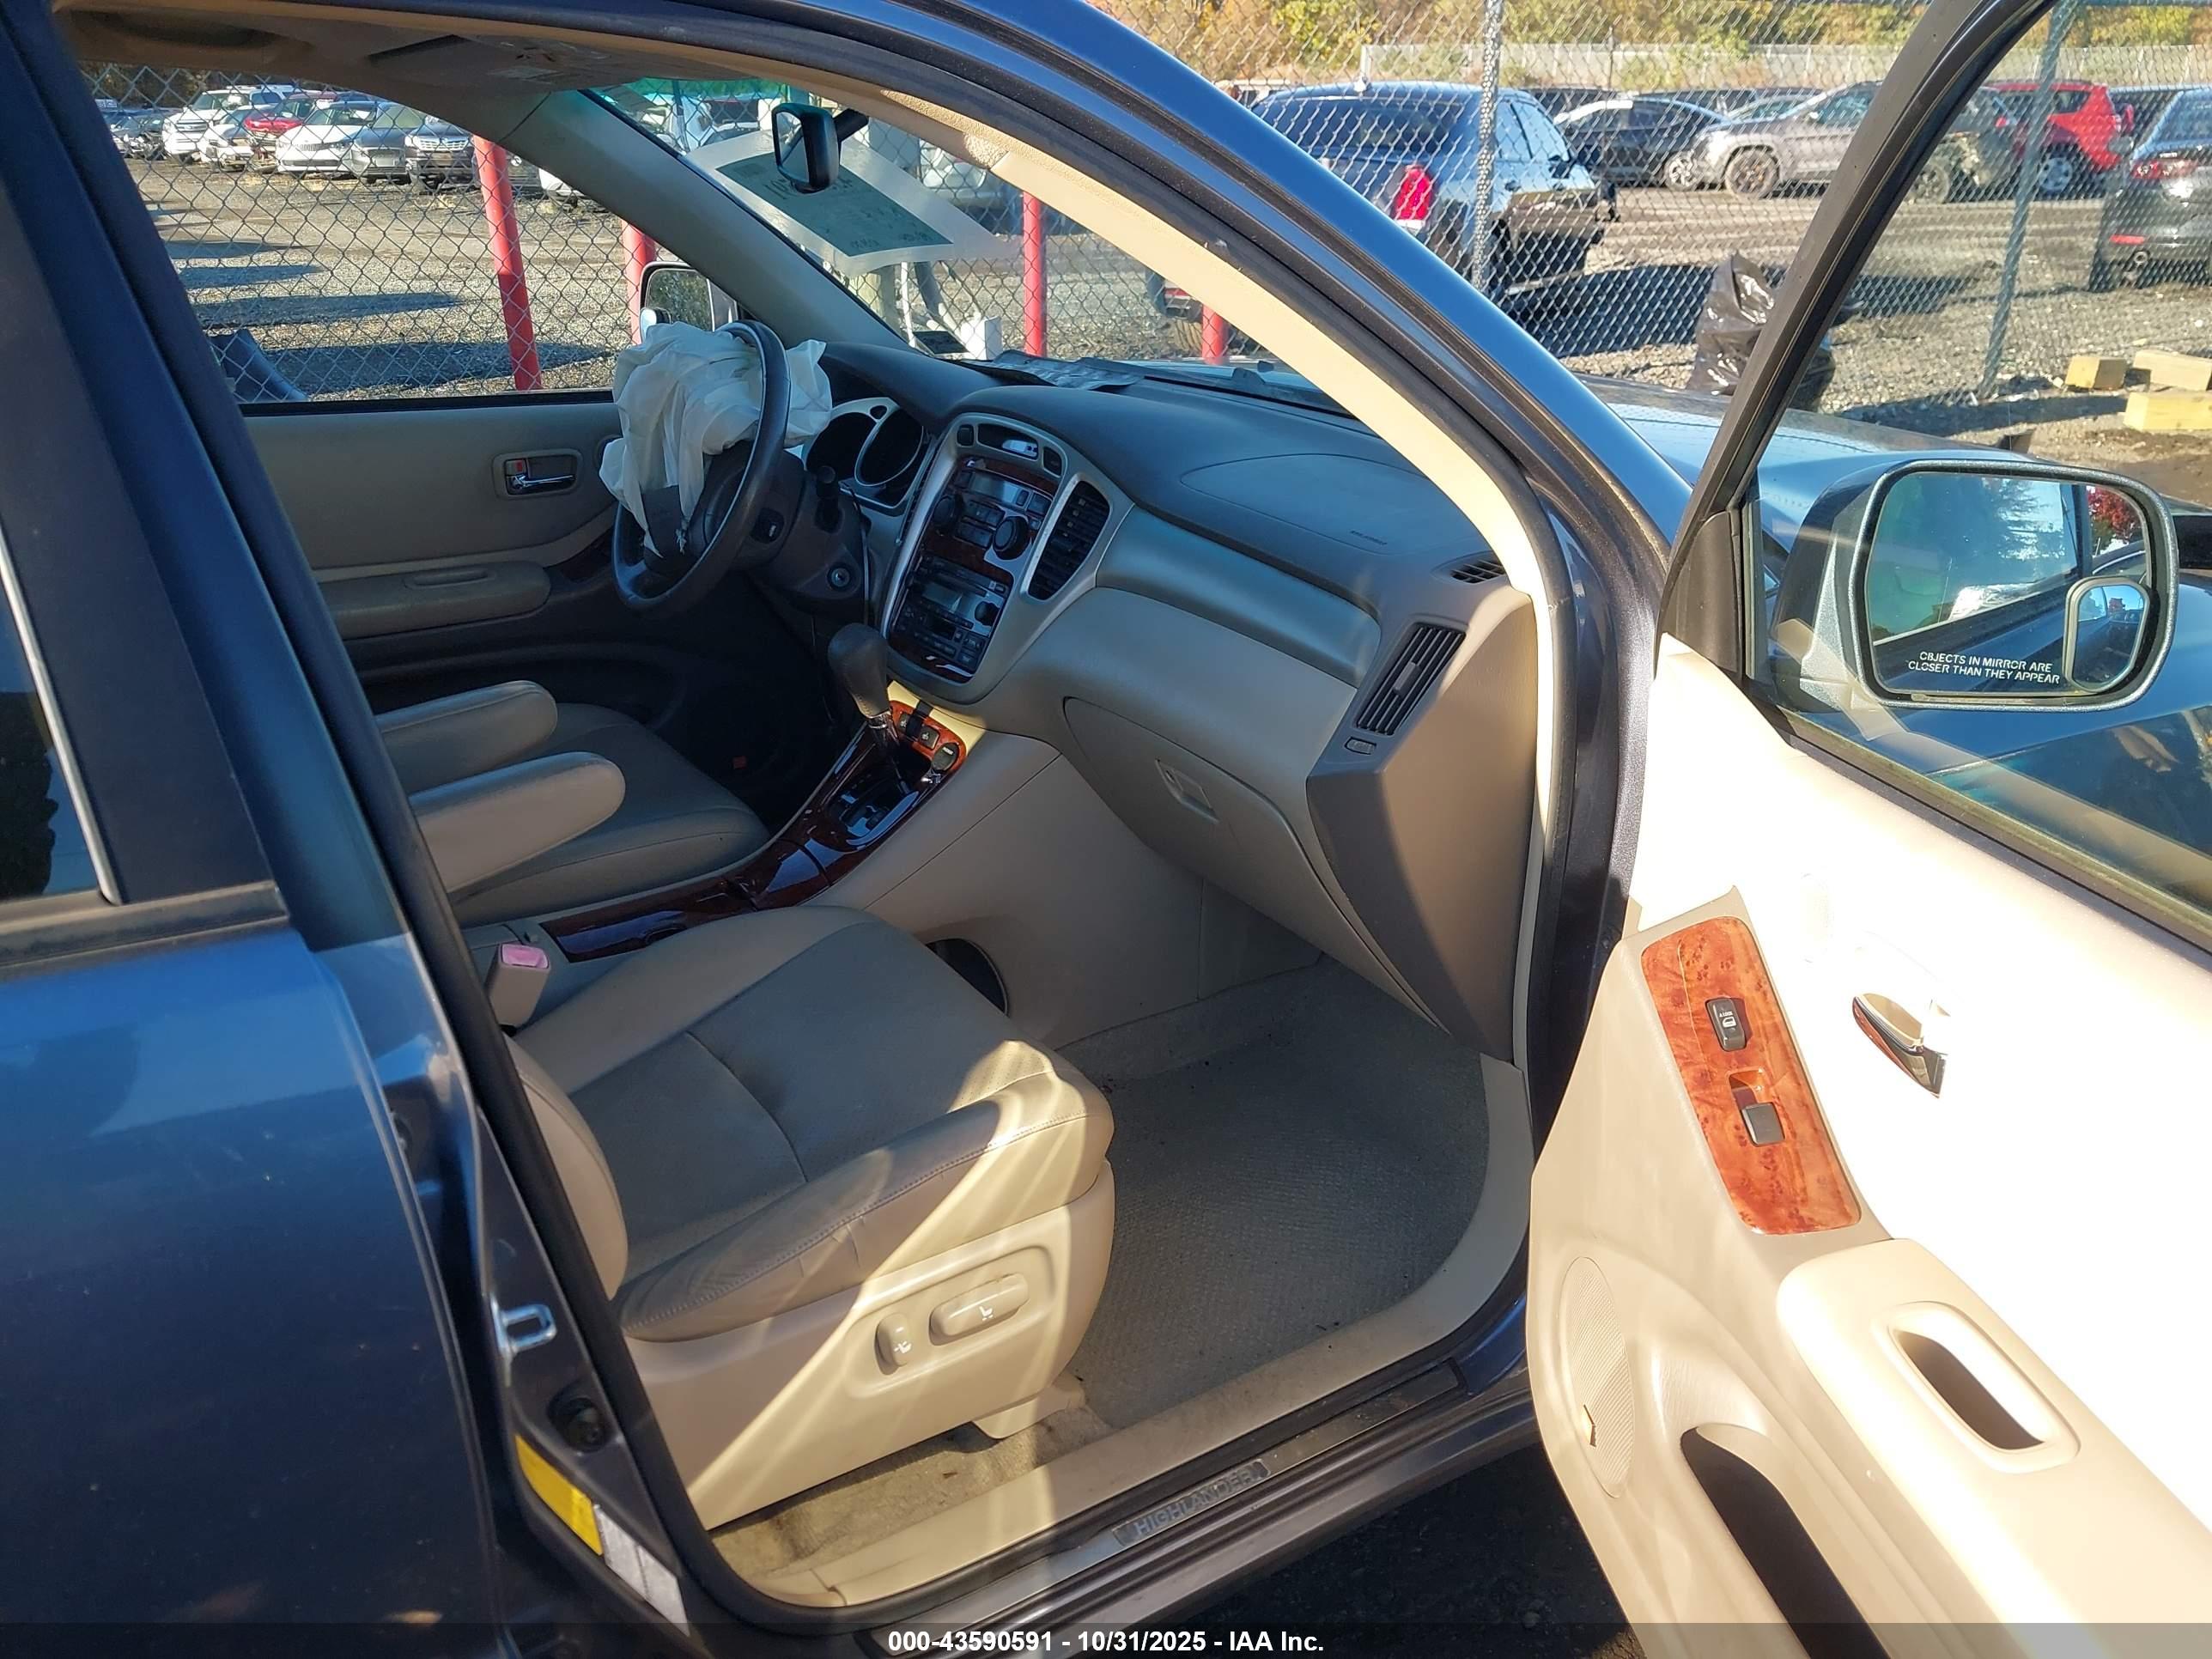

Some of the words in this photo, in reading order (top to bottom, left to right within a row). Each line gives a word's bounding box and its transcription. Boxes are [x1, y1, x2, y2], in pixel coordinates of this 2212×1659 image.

[1908, 660, 1950, 674] CLOSER
[1953, 665, 1982, 677] THAN
[1984, 668, 2013, 680] THEY
[2014, 671, 2061, 684] APPEAR
[1919, 651, 1966, 665] OBJECTS
[1968, 656, 1980, 666] IN
[1982, 657, 2027, 671] MIRROR
[2029, 662, 2053, 673] ARE
[1133, 1468, 1254, 1535] HIGHLANDER
